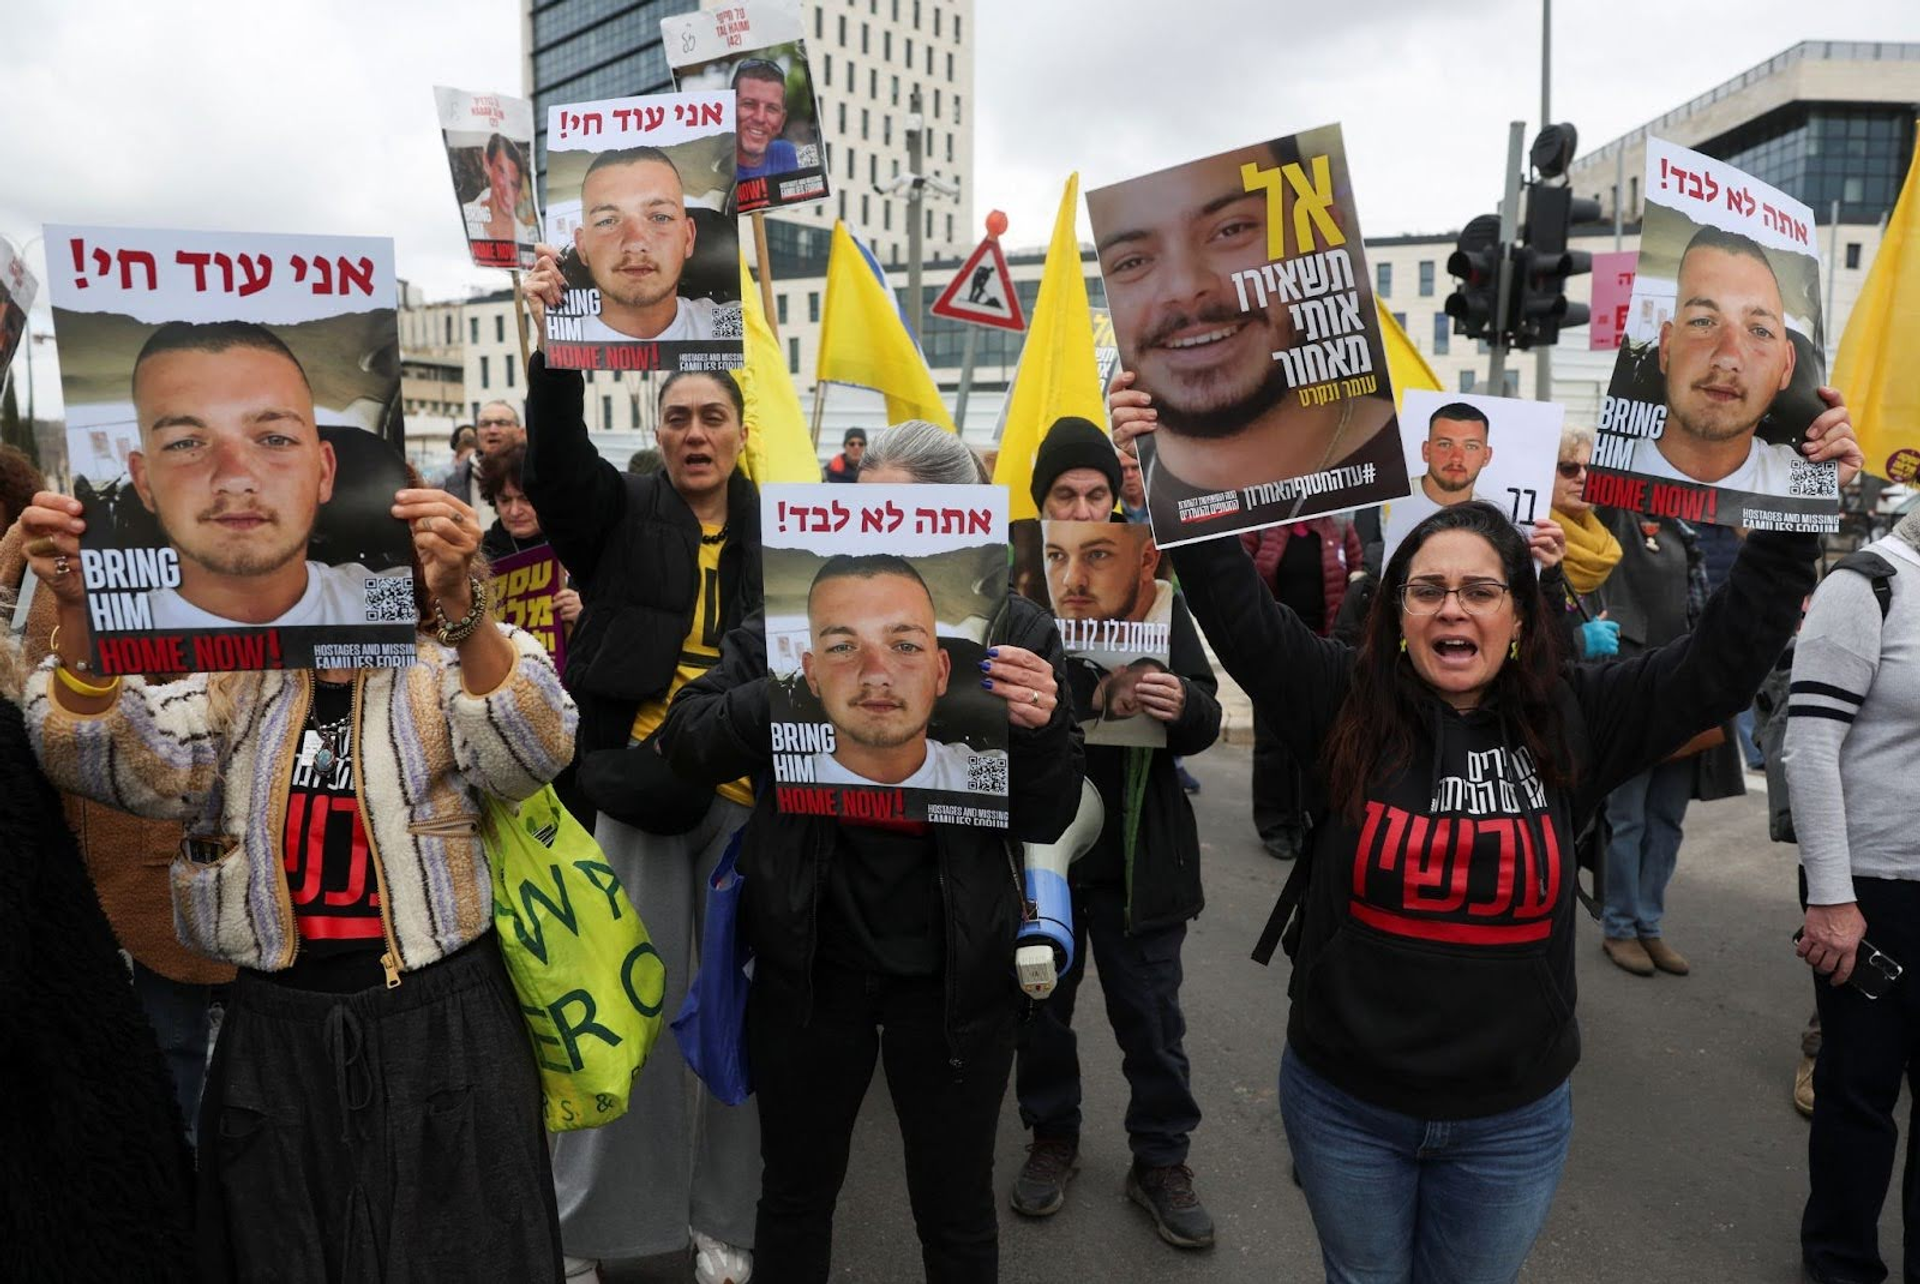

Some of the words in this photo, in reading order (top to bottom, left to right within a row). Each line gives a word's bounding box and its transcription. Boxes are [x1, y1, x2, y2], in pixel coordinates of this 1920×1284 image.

[560, 110, 603, 139] חי!
[612, 106, 665, 132] עוד
[674, 102, 724, 126] אני
[1660, 158, 1719, 203] לבד!
[1240, 154, 1347, 262] אל
[1726, 186, 1757, 218] לא
[1763, 202, 1808, 246] אתה
[70, 238, 157, 291] חי!
[175, 250, 273, 297] עוד
[290, 254, 374, 297] אני
[1230, 248, 1355, 313] תשאירו
[546, 288, 601, 315] RING
[1288, 290, 1366, 342] אותי
[546, 316, 583, 340] HIM
[547, 344, 600, 369] HOME
[605, 342, 660, 370] NOW!
[710, 352, 721, 361] AND
[1272, 334, 1373, 389] מאחור
[1298, 383, 1341, 408] ונקרט
[1344, 374, 1378, 399] עומר
[1600, 395, 1668, 439] BRING
[1591, 432, 1635, 471] HIM
[1243, 462, 1376, 511] #עדהחטוףהאחרון
[1584, 472, 1651, 513] HOME
[1650, 485, 1718, 524] NOW!
[777, 499, 851, 533] לבד!
[861, 499, 905, 533] לא
[915, 507, 992, 535] אתה
[1742, 507, 1783, 521] HOSTAGES
[1783, 512, 1800, 523] AND
[1801, 513, 1840, 525] MISSING
[80, 547, 181, 590] BRING
[88, 592, 154, 631] HIM
[97, 636, 186, 674] HOME
[191, 629, 284, 673] NOW!
[313, 643, 361, 657] HOSTAGES
[361, 643, 381, 656] AND
[770, 722, 836, 753] BRING
[773, 754, 816, 783] HIM
[776, 787, 838, 815] HOME
[841, 788, 905, 820] NOW!
[927, 803, 962, 816] HOSTAGES
[962, 807, 977, 818] AND
[978, 808, 1009, 821] MISSING
[1352, 800, 1561, 919] עכשיו
